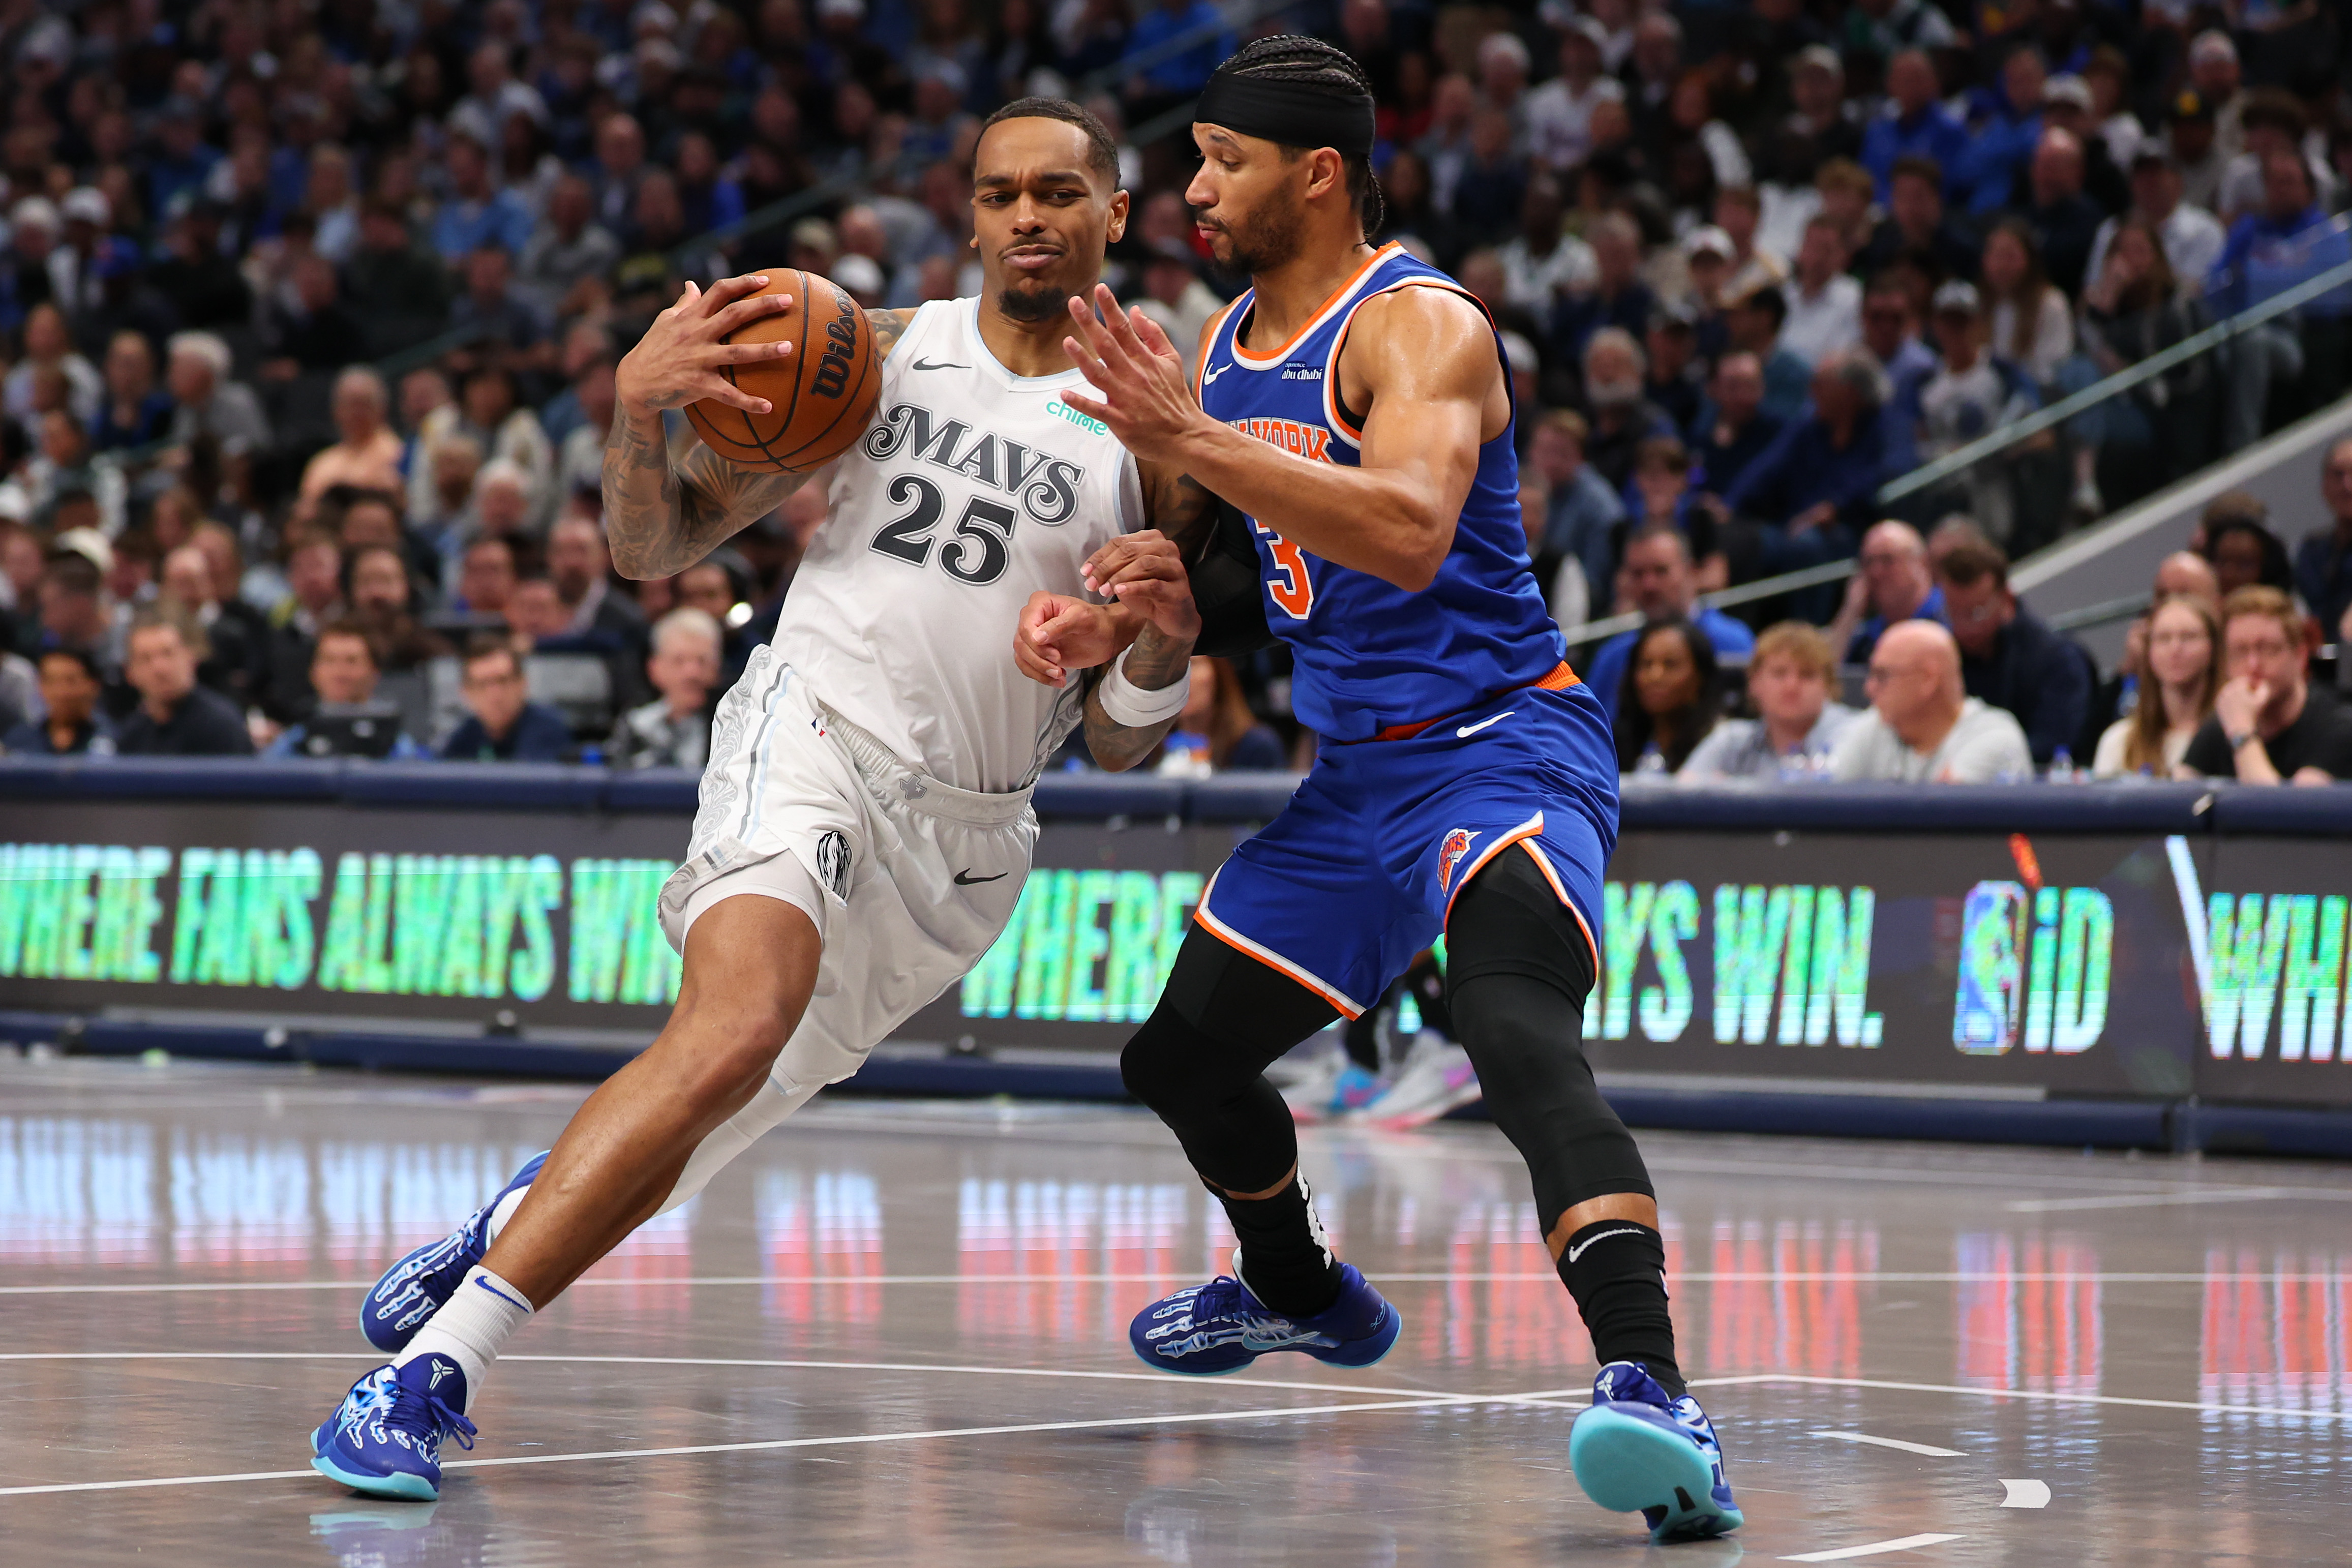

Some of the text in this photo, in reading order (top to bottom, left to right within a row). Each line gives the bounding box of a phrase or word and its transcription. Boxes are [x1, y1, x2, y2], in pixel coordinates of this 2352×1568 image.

[1046, 402, 1108, 436] chime
[1281, 369, 1323, 380] abu dhabi
[864, 402, 1085, 527] MAVS
[868, 473, 1018, 587] 25
[1254, 519, 1314, 620] 3
[169, 846, 323, 991] FANS
[317, 851, 563, 1003] ALWAYS
[961, 868, 1204, 1023] WHERE
[1713, 883, 1884, 1049] WIN.
